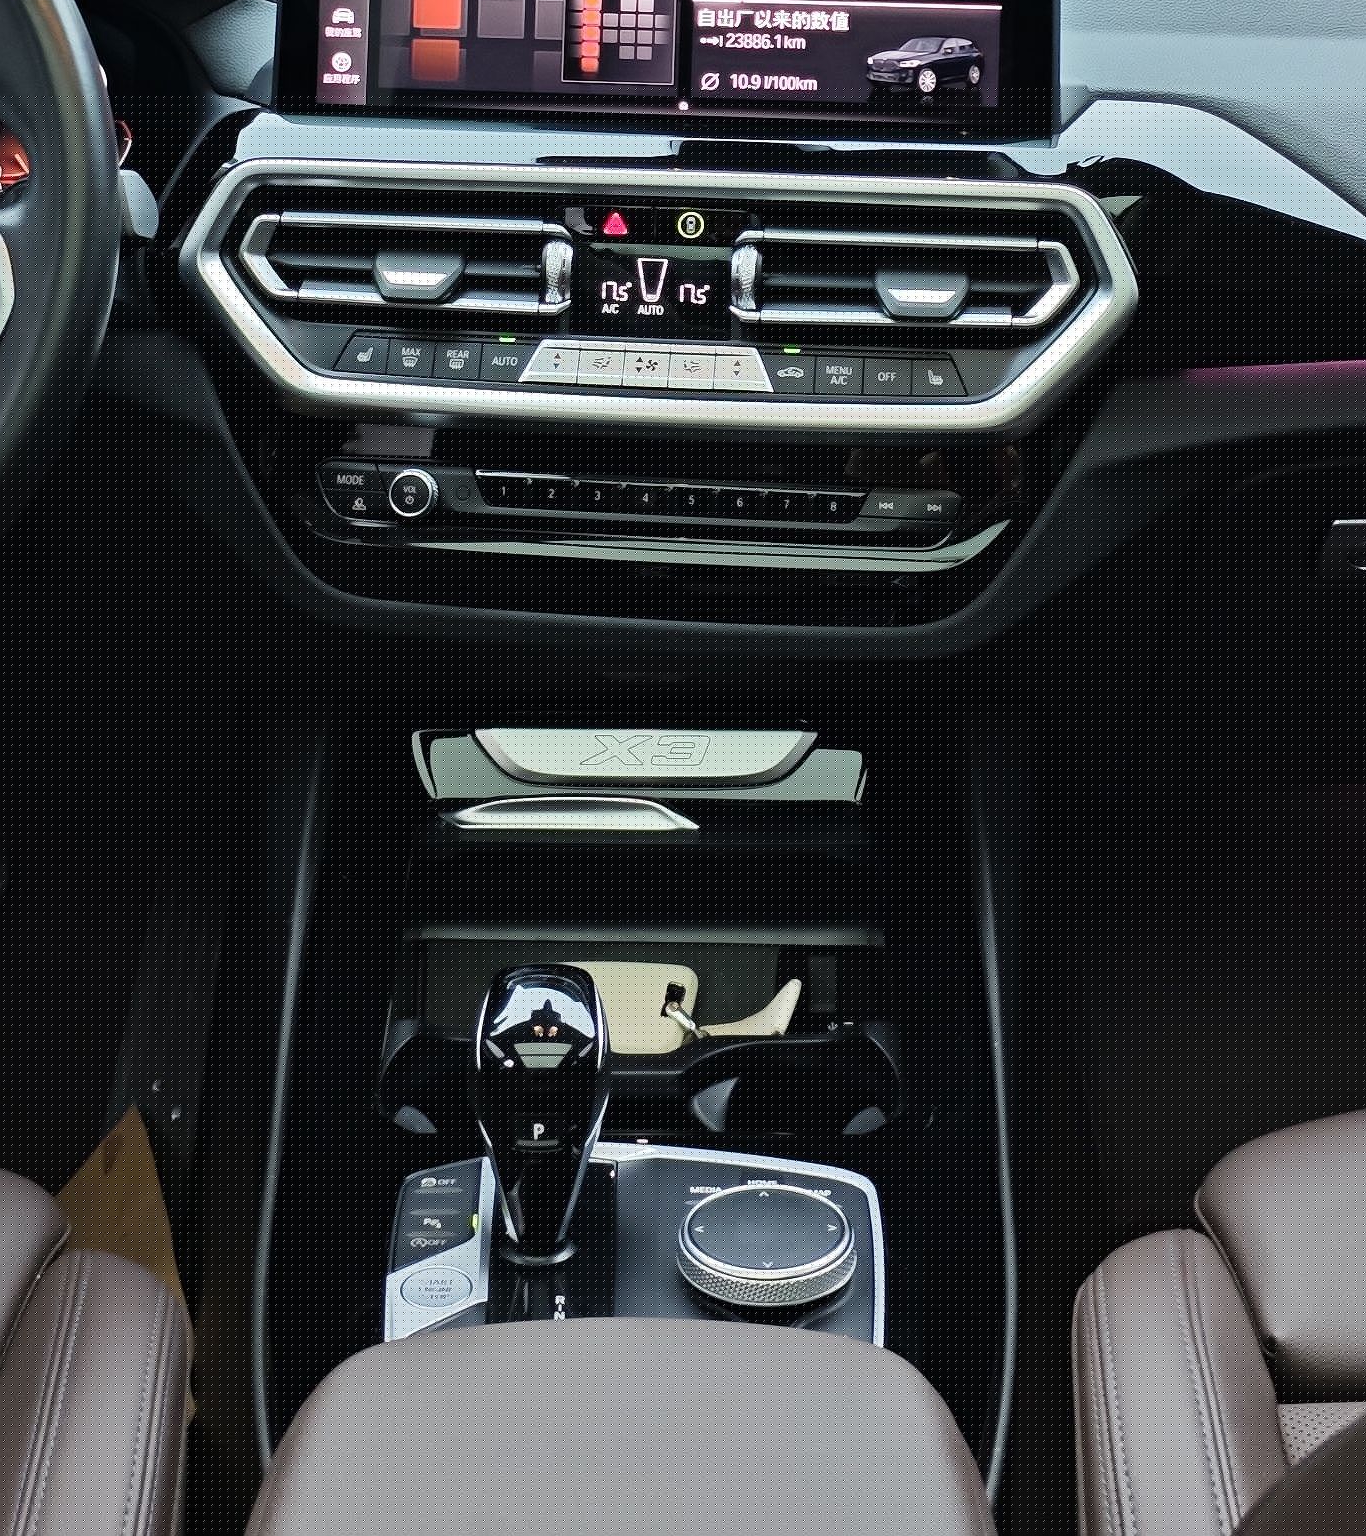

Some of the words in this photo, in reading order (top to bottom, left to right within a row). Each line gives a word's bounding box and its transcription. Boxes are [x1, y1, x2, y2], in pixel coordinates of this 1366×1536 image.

[697, 9, 850, 32] 自出厂以来的数值
[601, 303, 620, 314] A/C
[637, 304, 665, 316] AUTO
[401, 347, 421, 357] MAX
[446, 349, 470, 360] REAR
[491, 356, 518, 366] AUTO
[826, 365, 853, 375] MENU
[830, 376, 848, 386] A/C
[877, 371, 897, 382] OFF
[336, 474, 365, 486] MODE
[501, 486, 507, 497] 1
[548, 488, 556, 499] 2
[594, 490, 601, 501] 3
[642, 492, 649, 503] 4
[688, 494, 695, 506] 5
[736, 497, 744, 508] 6
[783, 499, 791, 510] 7
[829, 501, 838, 512] 8
[579, 733, 712, 767] X3
[534, 1123, 545, 1140] P
